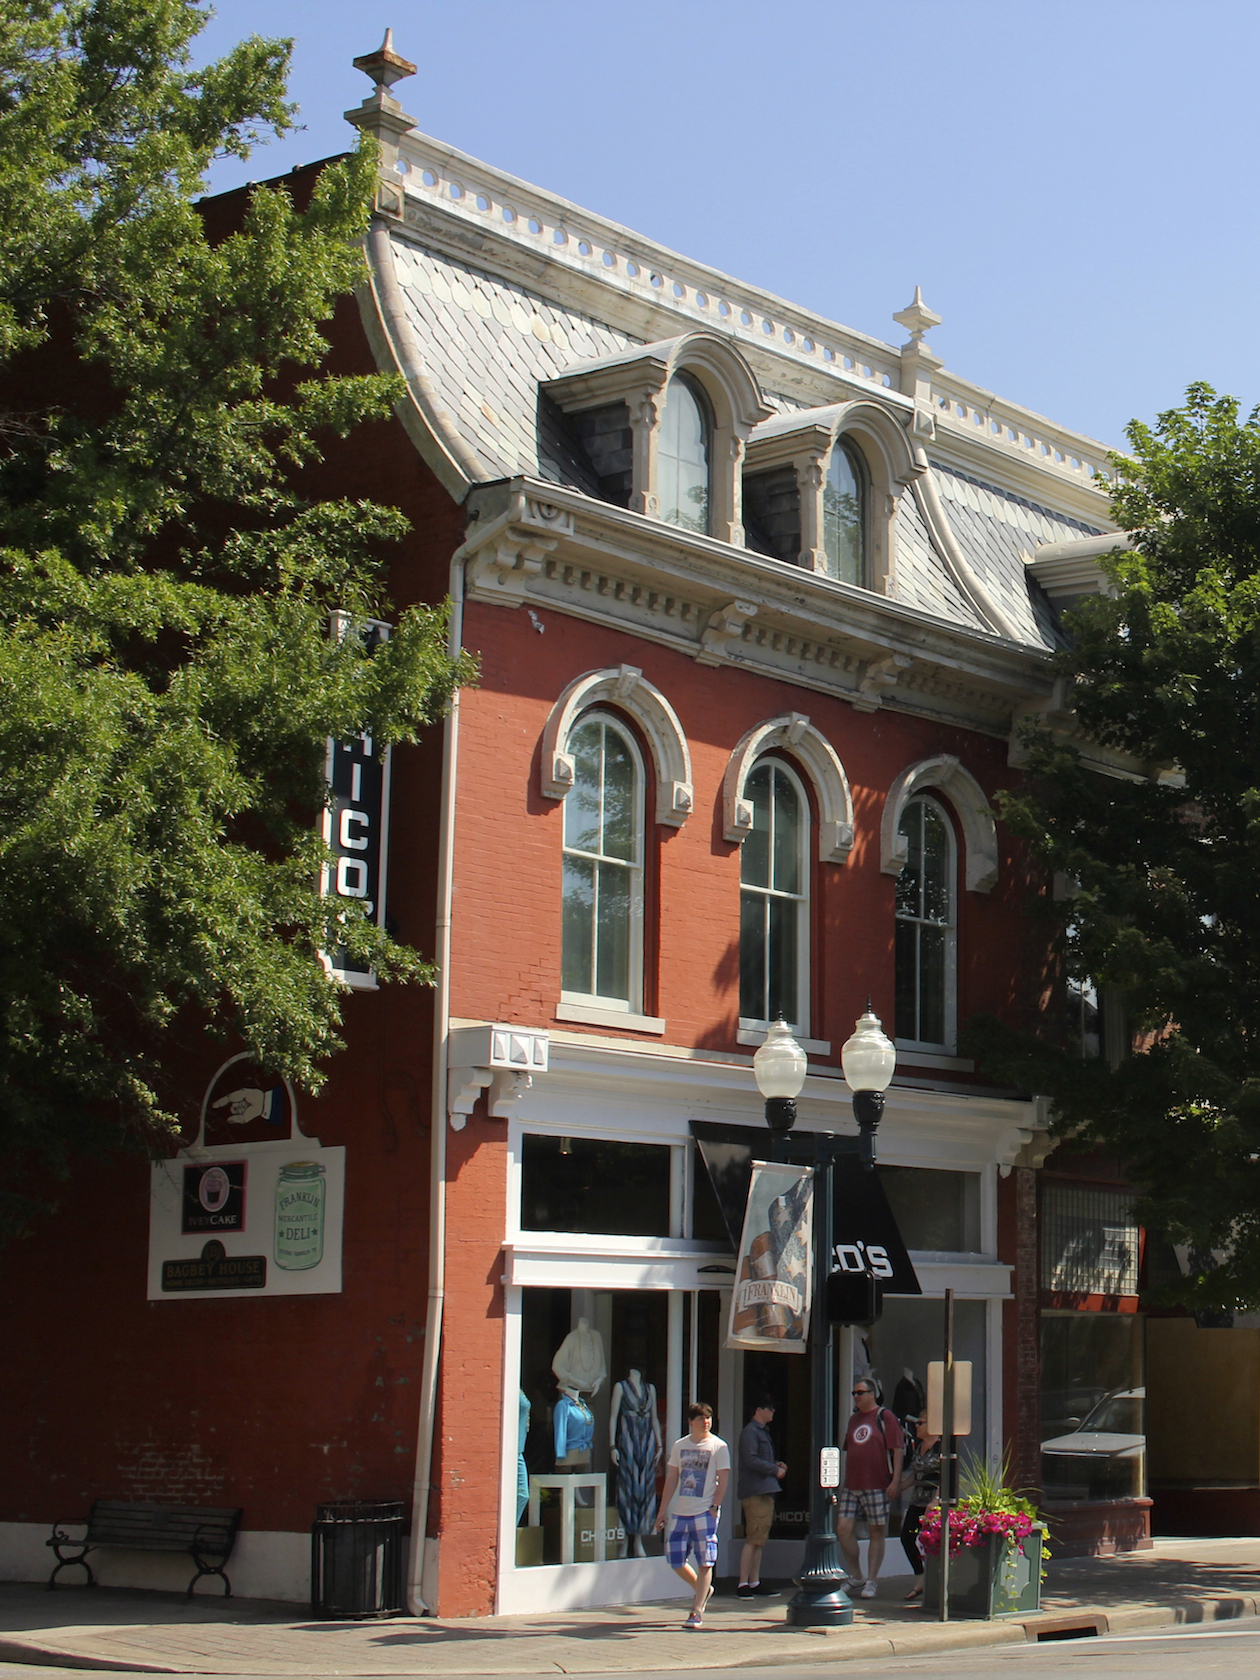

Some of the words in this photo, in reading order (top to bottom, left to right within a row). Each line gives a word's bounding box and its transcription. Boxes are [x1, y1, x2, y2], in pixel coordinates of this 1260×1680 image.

[279, 1191, 320, 1210] FRANKLIN
[278, 1213, 318, 1223] MERCANTILE
[286, 1227, 311, 1241] DELI
[167, 1262, 214, 1278] BAGBEY
[219, 1261, 260, 1275] HOUSE
[747, 1282, 796, 1302] FRANKLIN
[581, 1526, 625, 1543] CHO'S
